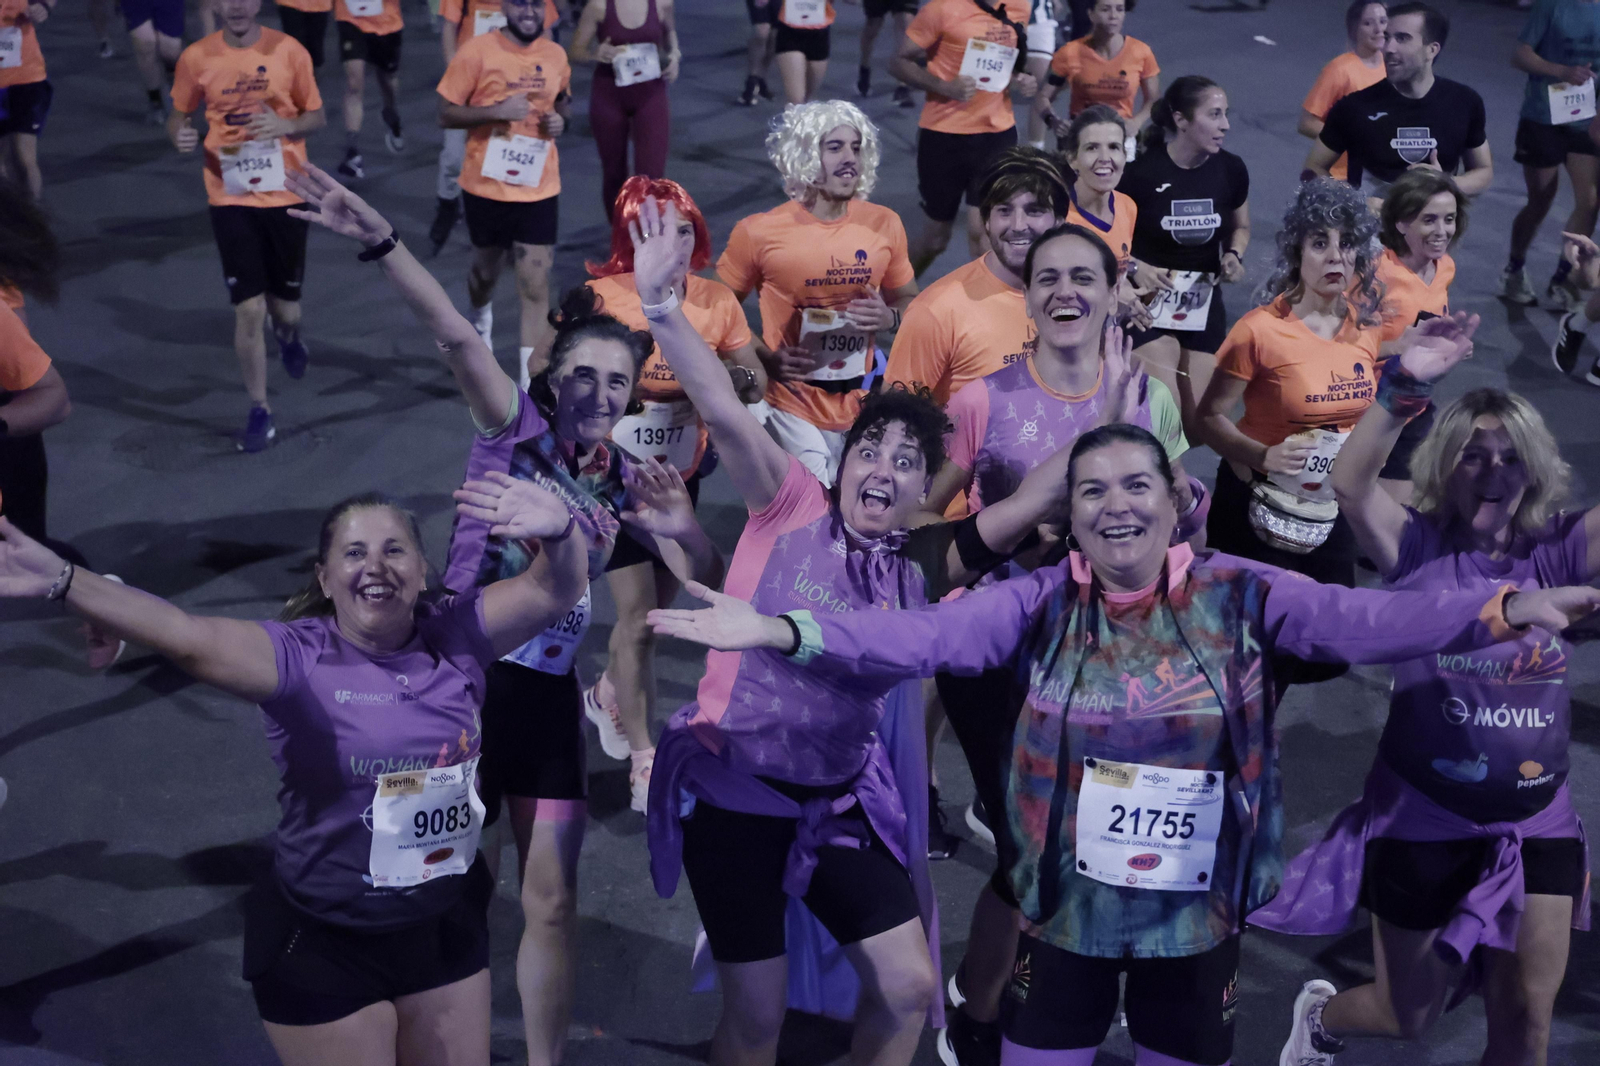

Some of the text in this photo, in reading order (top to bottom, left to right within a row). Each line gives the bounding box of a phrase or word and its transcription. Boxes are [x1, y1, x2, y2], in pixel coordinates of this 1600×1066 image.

[501, 148, 534, 165] 15424
[1183, 205, 1202, 213] CLUB
[1167, 216, 1217, 227] TRIATLÓN
[826, 267, 872, 277] NOCTURNA
[804, 277, 846, 287] SEVILLA
[1163, 289, 1200, 306] 21671
[820, 334, 864, 352] 13900
[1327, 380, 1372, 392] NOCTURNA
[1304, 387, 1373, 403] SEVILLA KH7
[634, 426, 684, 445] 13977
[794, 573, 853, 614] WOMA
[1437, 652, 1508, 677] WOMAN
[351, 754, 433, 776] WOMAN
[414, 802, 471, 838] 9083
[1108, 804, 1196, 839] 21755
[1100, 835, 1131, 846] FRANCISCA
